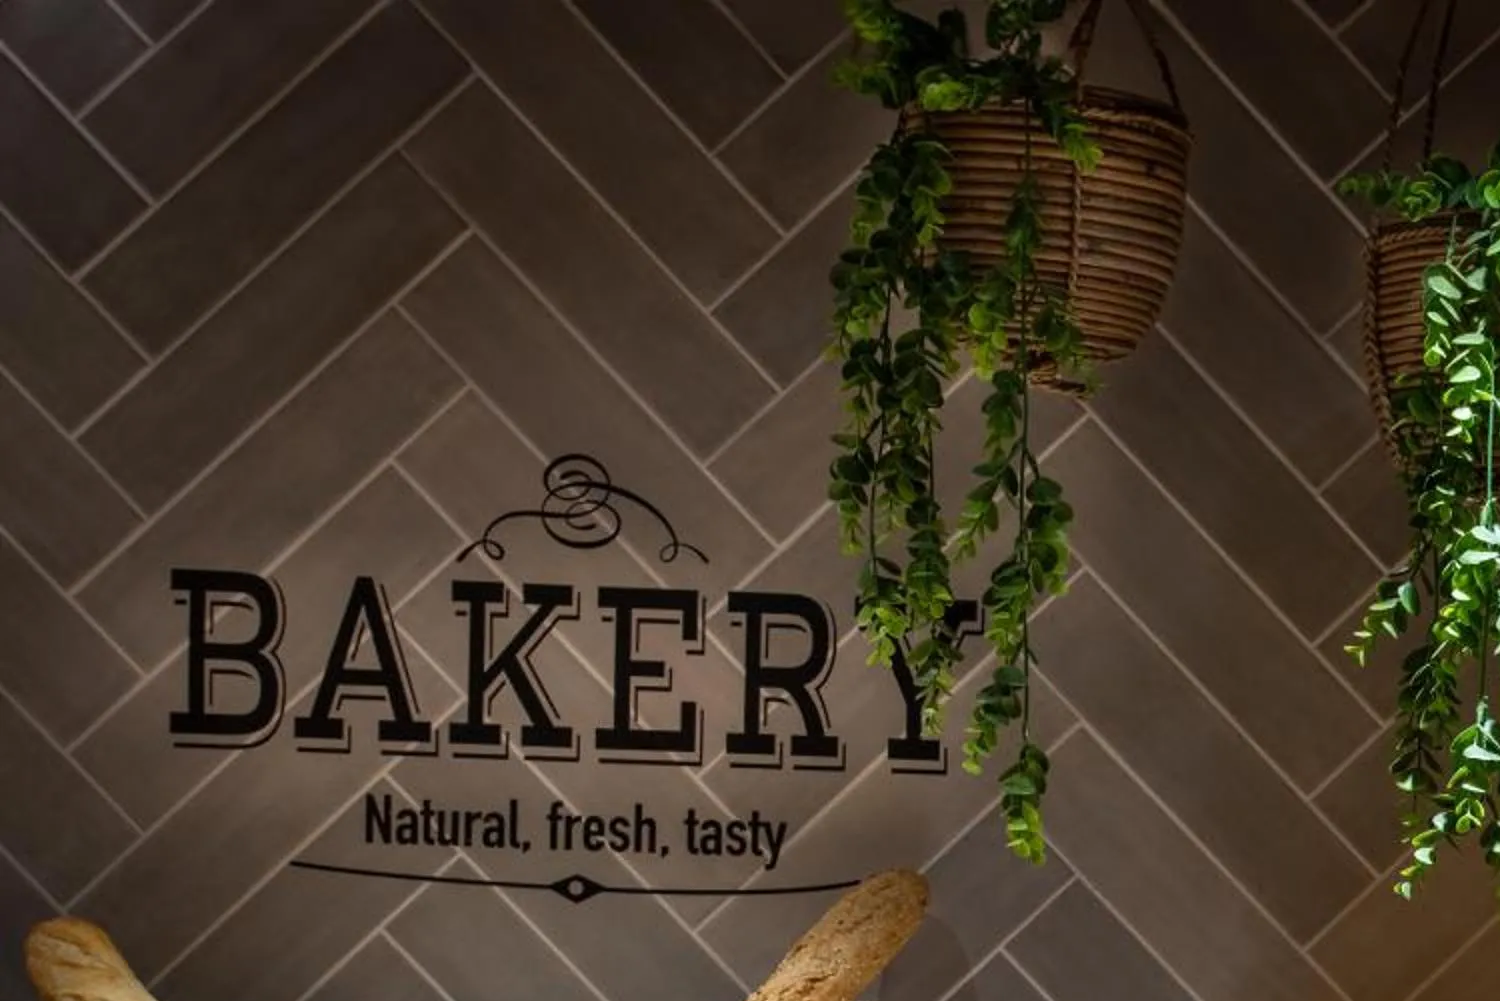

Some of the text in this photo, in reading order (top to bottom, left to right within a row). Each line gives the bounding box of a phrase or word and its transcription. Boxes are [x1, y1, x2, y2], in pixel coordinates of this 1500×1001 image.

[168, 568, 984, 775] BAKERY
[365, 794, 788, 871] Natural, fresh, tasty
